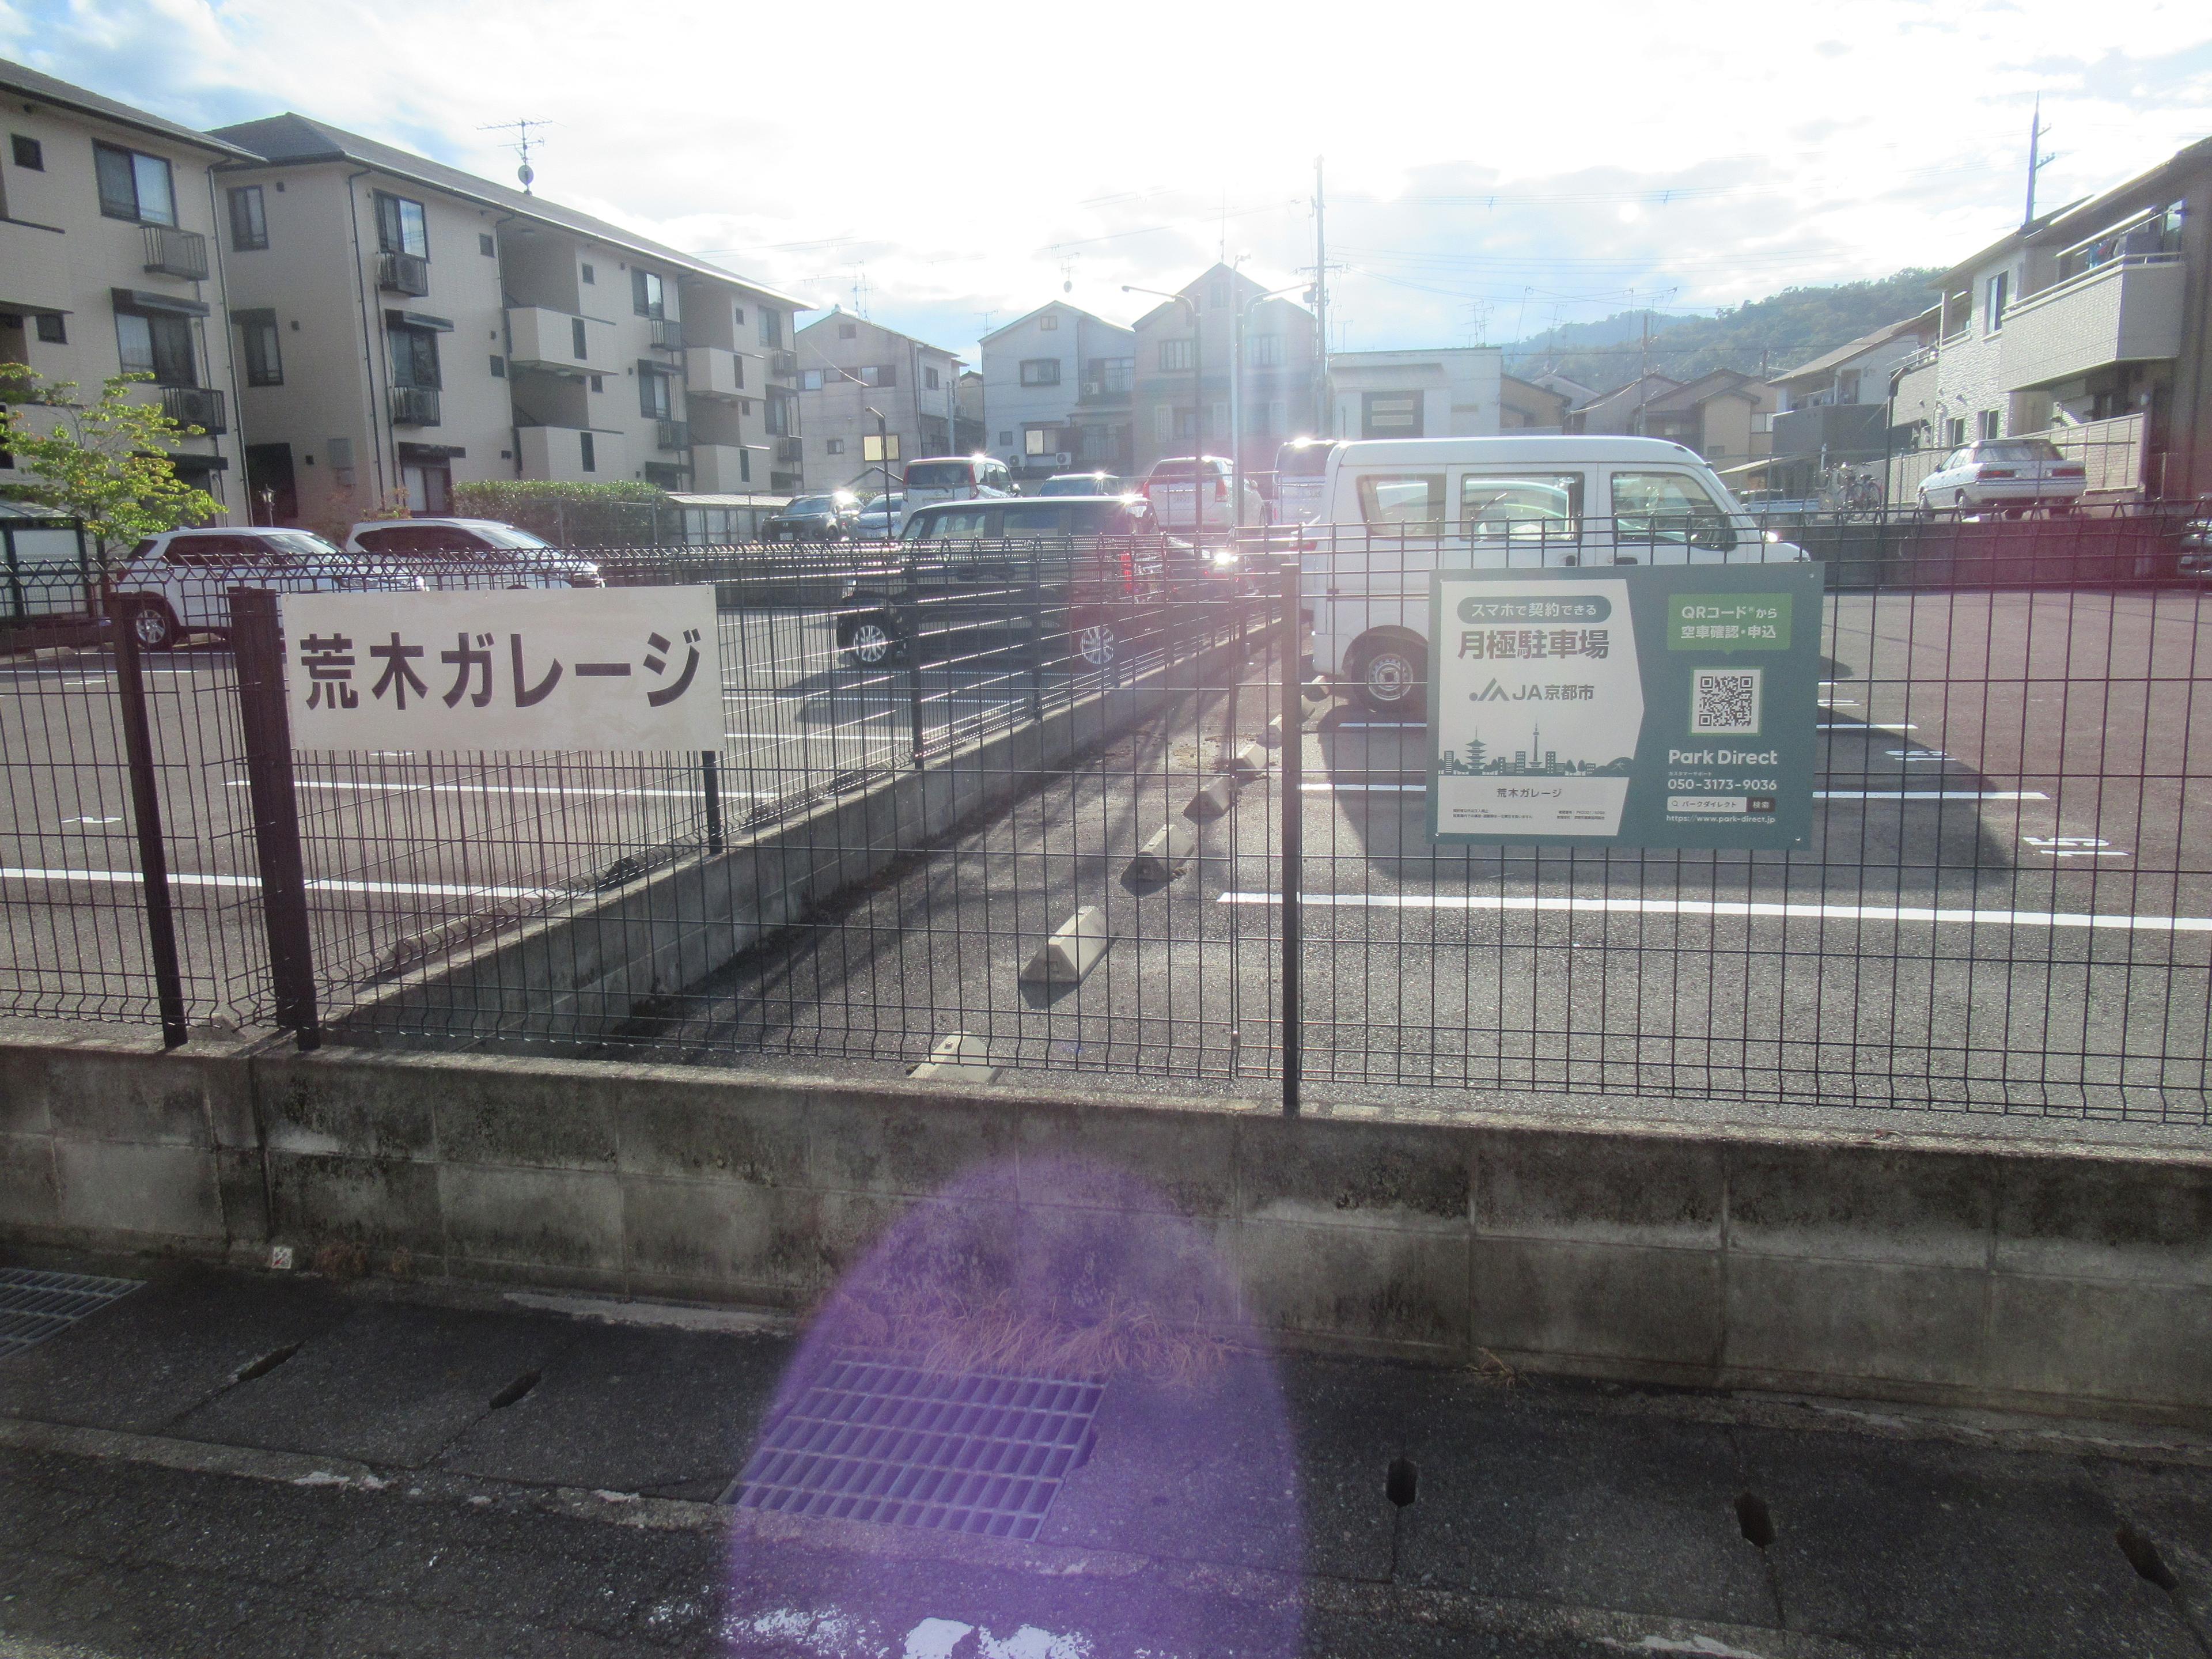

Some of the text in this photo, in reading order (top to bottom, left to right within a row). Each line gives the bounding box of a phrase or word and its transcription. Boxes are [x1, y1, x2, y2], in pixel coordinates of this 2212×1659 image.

[1471, 603, 1597, 618] スマホで契約できる
[1681, 625, 1777, 639] 空車確認・申込
[1457, 629, 1609, 660] 月極駐車場
[300, 628, 701, 710] 荒木ガレージ
[1668, 749, 1778, 765] Park Direct
[1668, 778, 1778, 790] 050-3173-9036
[1497, 788, 1562, 798] 荒木ガレージ
[1666, 815, 1776, 824] https://www.park-direct.jp
